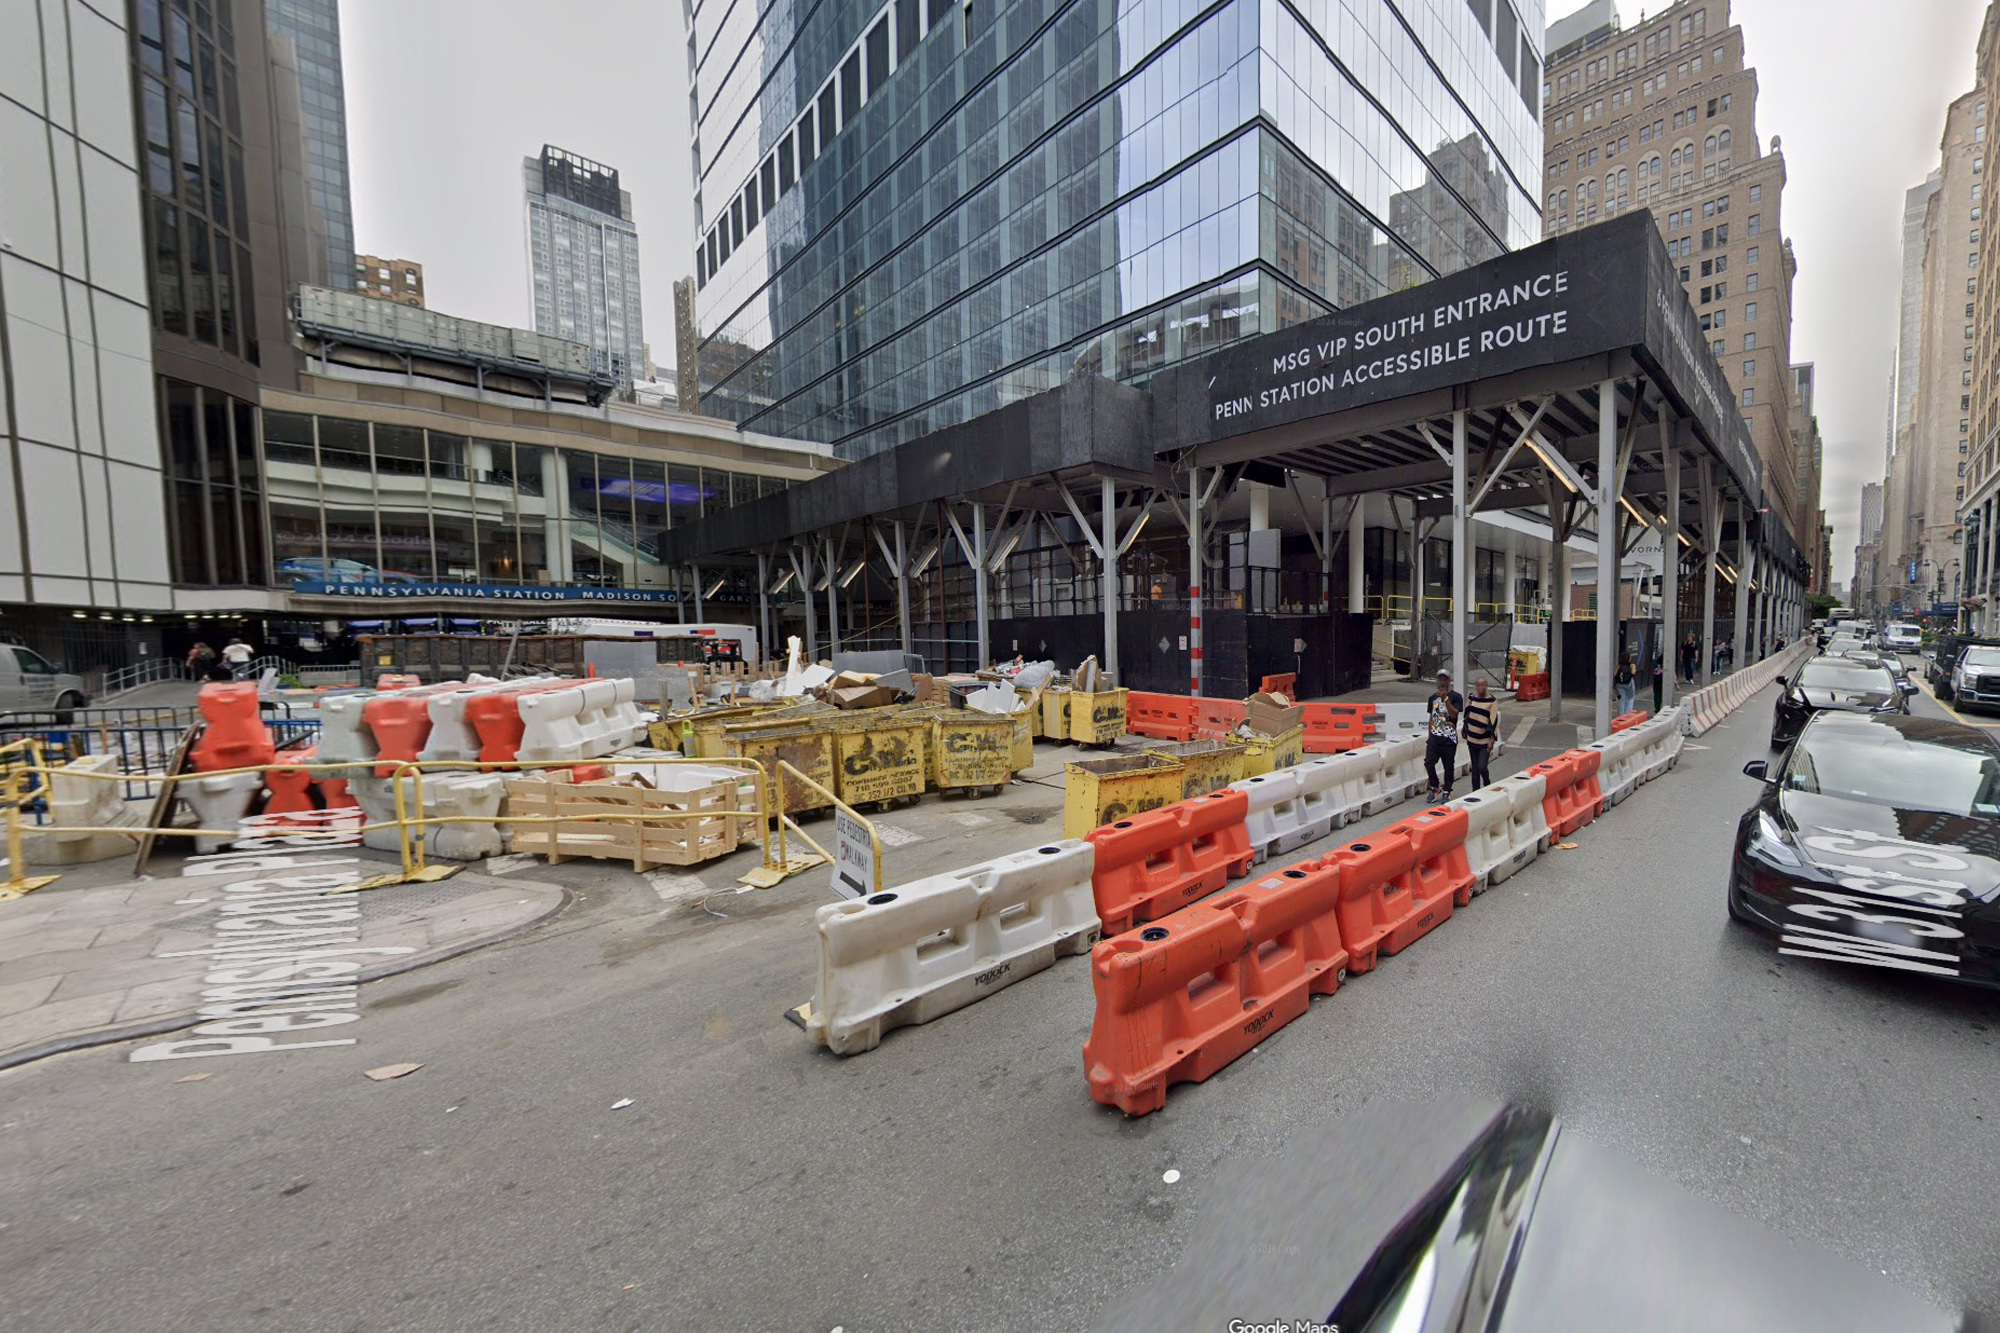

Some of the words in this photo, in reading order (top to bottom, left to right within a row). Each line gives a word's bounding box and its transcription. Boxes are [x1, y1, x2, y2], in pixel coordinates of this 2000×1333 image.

[1273, 349, 1310, 374] MSG
[1317, 337, 1347, 360] VIP
[1354, 313, 1424, 350] SOUTH
[1434, 271, 1568, 328] ENTRANCE
[1216, 395, 1252, 420] PENN
[1260, 374, 1334, 408] STATION
[1341, 336, 1470, 387] ACCESSIBLE
[1481, 311, 1567, 352] ROUTE
[1631, 546, 1664, 554] VORN
[325, 585, 485, 597] PENNSYLVANIA
[494, 589, 565, 600] STATION
[582, 591, 651, 601] MADISON
[868, 789, 881, 800] 252
[975, 963, 1011, 986] YODOCK
[1244, 1009, 1274, 1035] YODOCK
